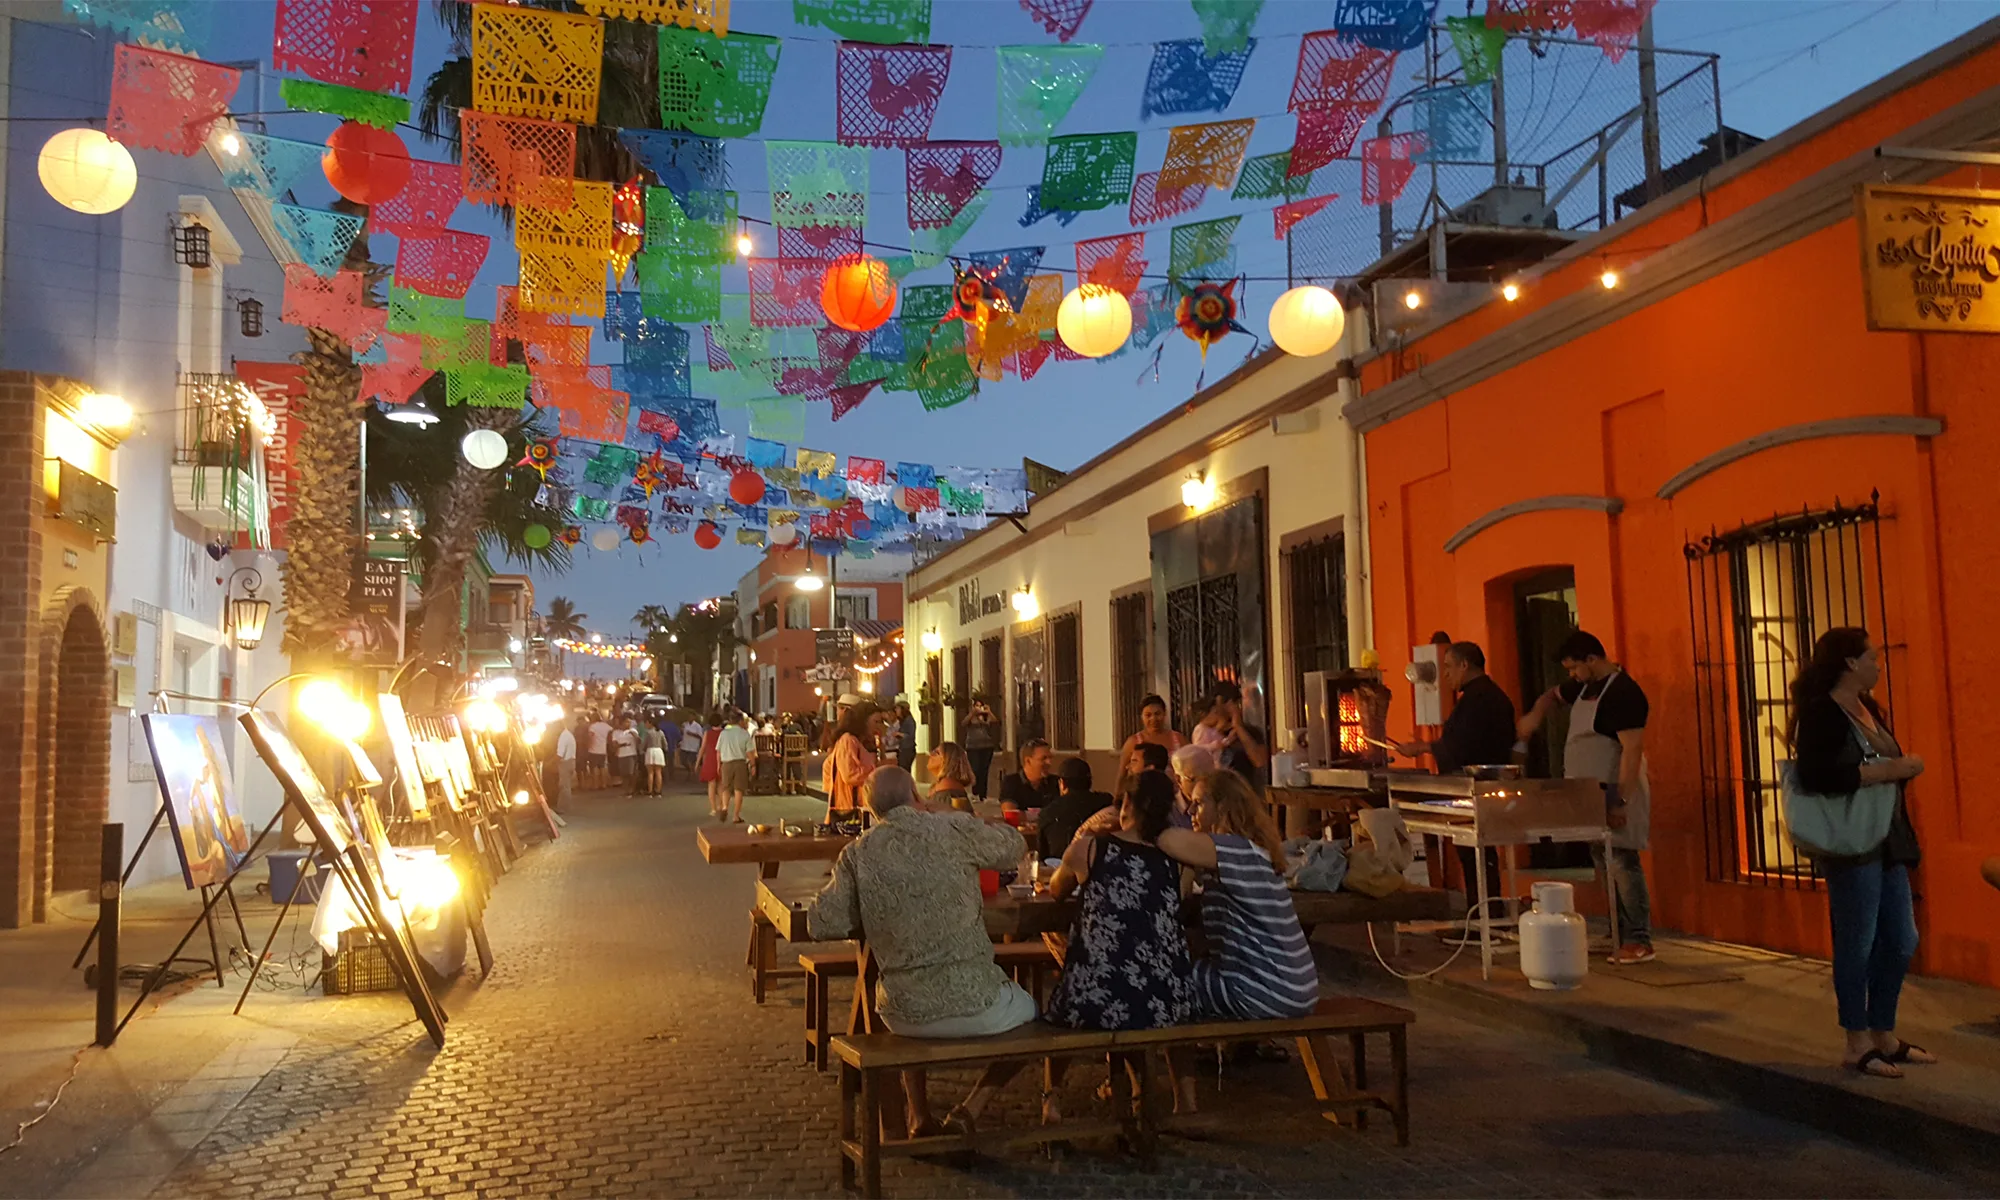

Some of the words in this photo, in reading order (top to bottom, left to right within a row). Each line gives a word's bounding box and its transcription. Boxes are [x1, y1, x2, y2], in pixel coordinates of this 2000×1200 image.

[1910, 225, 1988, 277] Lupita
[365, 562, 396, 574] EAT
[364, 575, 397, 585] SHOP
[364, 587, 395, 597] PLAY
